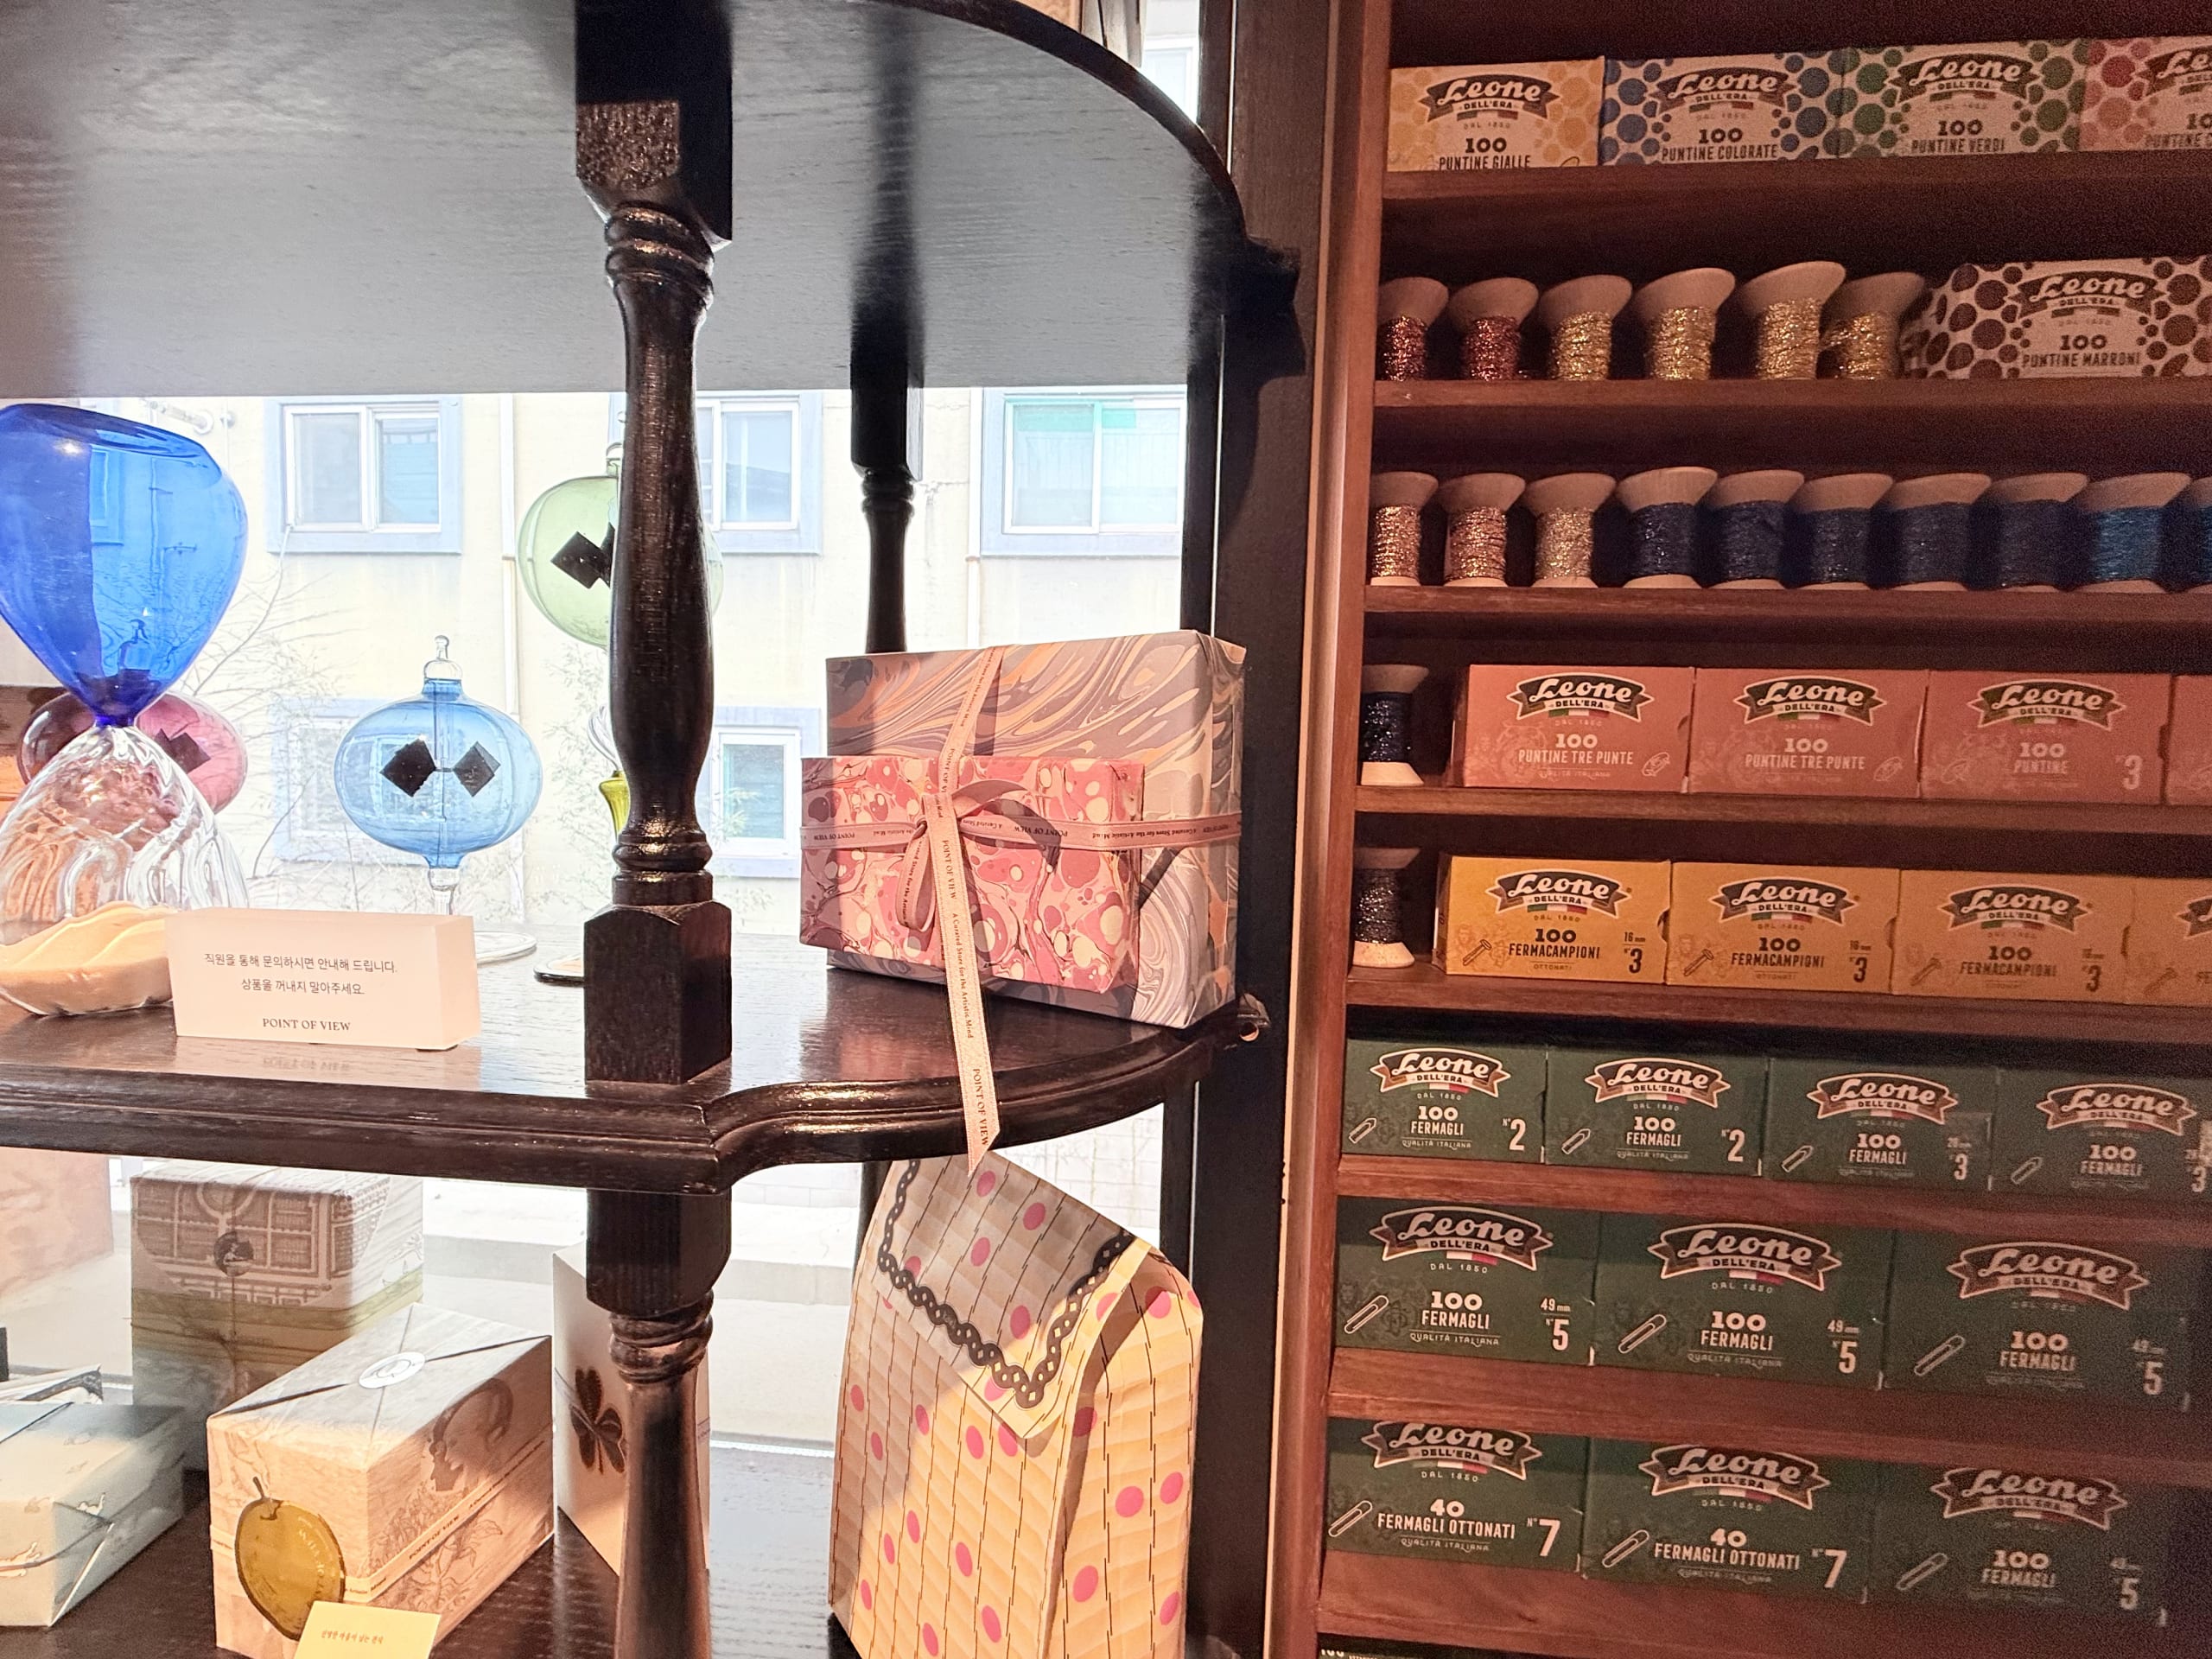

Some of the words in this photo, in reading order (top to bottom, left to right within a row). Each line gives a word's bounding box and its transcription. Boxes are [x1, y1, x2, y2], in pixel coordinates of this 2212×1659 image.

[1909, 60, 2022, 86] Leone
[1437, 79, 1541, 107] Leone
[1668, 71, 1777, 99] Leone
[1464, 99, 1512, 109] DELL'ERA
[1699, 129, 1743, 143] 100
[1937, 120, 1983, 136] 100
[1465, 137, 1507, 153] 100
[1662, 146, 1714, 160] PUNTINE
[1718, 144, 1777, 159] COLORATE
[1911, 139, 1966, 154] PUNTINE
[1440, 156, 1490, 169] PUNTINE
[1492, 156, 1530, 168] GIALLE
[2031, 276, 2145, 301] Leone
[2060, 334, 2108, 350] 100
[2022, 353, 2078, 367] PUNTINE
[1529, 677, 1631, 702] Leone
[1757, 681, 1865, 707] Leone
[1992, 685, 2103, 710] Leone
[1554, 699, 1605, 709] DELL'ERA
[1785, 703, 1835, 712] DELL'ERA
[1555, 734, 1598, 747] 100
[1784, 739, 1827, 753] 100
[1519, 750, 1567, 764] PUNTINE
[1572, 751, 1592, 764] TRE
[1597, 752, 1633, 765] PUNTE
[2019, 743, 2066, 758] 100
[1745, 754, 1795, 769] PUNTINE
[1799, 755, 1821, 769] TRE
[1825, 756, 1866, 769] PUNTE
[2014, 760, 2068, 774] PUNTINE
[2123, 755, 2143, 790] 3
[943, 840, 951, 862] POINT
[946, 866, 953, 874] OF
[948, 878, 957, 899] VIEW
[1508, 874, 1610, 900] Leone
[1731, 882, 1835, 907] Leone
[1535, 896, 1582, 905] DELL'ERA
[1758, 903, 1808, 912] DELL'ERA
[1961, 890, 2069, 915] Leone
[1535, 929, 1577, 944] 100
[1624, 931, 1634, 943] 16
[1758, 938, 1801, 952] 100
[1509, 944, 1600, 959] FERMACAMPIONI
[1731, 952, 1824, 969] FERMACAMPIONI
[1989, 946, 2032, 960] 100
[205, 954, 235, 967] 직원을
[239, 956, 259, 967] 통해
[263, 956, 315, 969] 문의하시면
[317, 958, 349, 971] 안내해
[353, 959, 397, 973] 드립니다.
[952, 920, 962, 945] Curated
[961, 992, 969, 1018] Artistic
[1629, 948, 1643, 975] 3
[1853, 957, 1867, 983] 3
[241, 978, 272, 991] 상품을
[275, 981, 307, 993] 꺼내지
[2085, 964, 2101, 993] 3
[263, 1019, 299, 1029] POINT
[302, 1020, 317, 1030] OF
[320, 1021, 351, 1031] VIEW
[1391, 1052, 1489, 1078] Leone
[973, 1069, 983, 1098] POINT
[1417, 1074, 1463, 1084] DELL'ERA
[1608, 1064, 1708, 1090] Leone
[1634, 1084, 1681, 1094] DELL'ERA
[1830, 1078, 1936, 1106] Leone
[978, 1102, 986, 1115] OF
[1858, 1100, 1907, 1110] DELL'ERA
[2061, 1089, 2173, 1116] Leone
[1418, 1106, 1458, 1121] 100
[980, 1119, 988, 1145] VIEW
[1411, 1122, 1464, 1136] FERMAGLI
[1634, 1116, 1675, 1132] 100
[1510, 1119, 1526, 1151] 2
[1627, 1132, 1681, 1147] FERMAGLI
[1857, 1134, 1901, 1148] 100
[1727, 1129, 1744, 1162] 2
[2089, 1145, 2136, 1161] 100
[1849, 1149, 1906, 1166] FERMAGLI
[1954, 1154, 1968, 1180] 3
[2080, 1161, 2143, 1177] FERMAGLI
[2191, 1166, 2206, 1192] 3
[1398, 1212, 1525, 1246] Leone
[1430, 1240, 1490, 1252] DELL'ERA
[1678, 1230, 1812, 1266] Leone
[1713, 1258, 1776, 1270] DELL'ERA
[1978, 1248, 2118, 1284] Leone
[1431, 1292, 1483, 1311] 100
[1541, 1299, 1555, 1312] 49
[1422, 1310, 1490, 1330] FERMAGLI
[1712, 1311, 1766, 1332] 100
[1827, 1320, 1843, 1332] 49
[1455, 1336, 1499, 1348] ITALIANA
[1552, 1319, 1569, 1351] 5
[1700, 1330, 1773, 1351] FERMAGLI
[2011, 1331, 2069, 1351] 100
[1839, 1342, 1858, 1373] 5
[2000, 1351, 2075, 1371] FERMAGLI
[2143, 1361, 2164, 1395] 5
[1389, 1423, 1514, 1456] Leone
[1421, 1449, 1479, 1460] DELL'ERA
[1668, 1448, 1801, 1484] Leone
[1703, 1476, 1764, 1489] DELL'ERA
[1962, 1471, 2101, 1505] Leone
[1430, 1499, 1465, 1517] 40
[1377, 1513, 1444, 1534] FERMAGLI
[1449, 1519, 1515, 1539] OTTONATI
[1539, 1519, 1560, 1557] 7
[1710, 1528, 1747, 1548] 40
[1655, 1542, 1725, 1563] FERMAGLI
[1730, 1549, 1800, 1570] OTTONATI
[1993, 1549, 2050, 1569] 100
[1824, 1549, 1847, 1588] 7
[2120, 1578, 2139, 1610] 5
